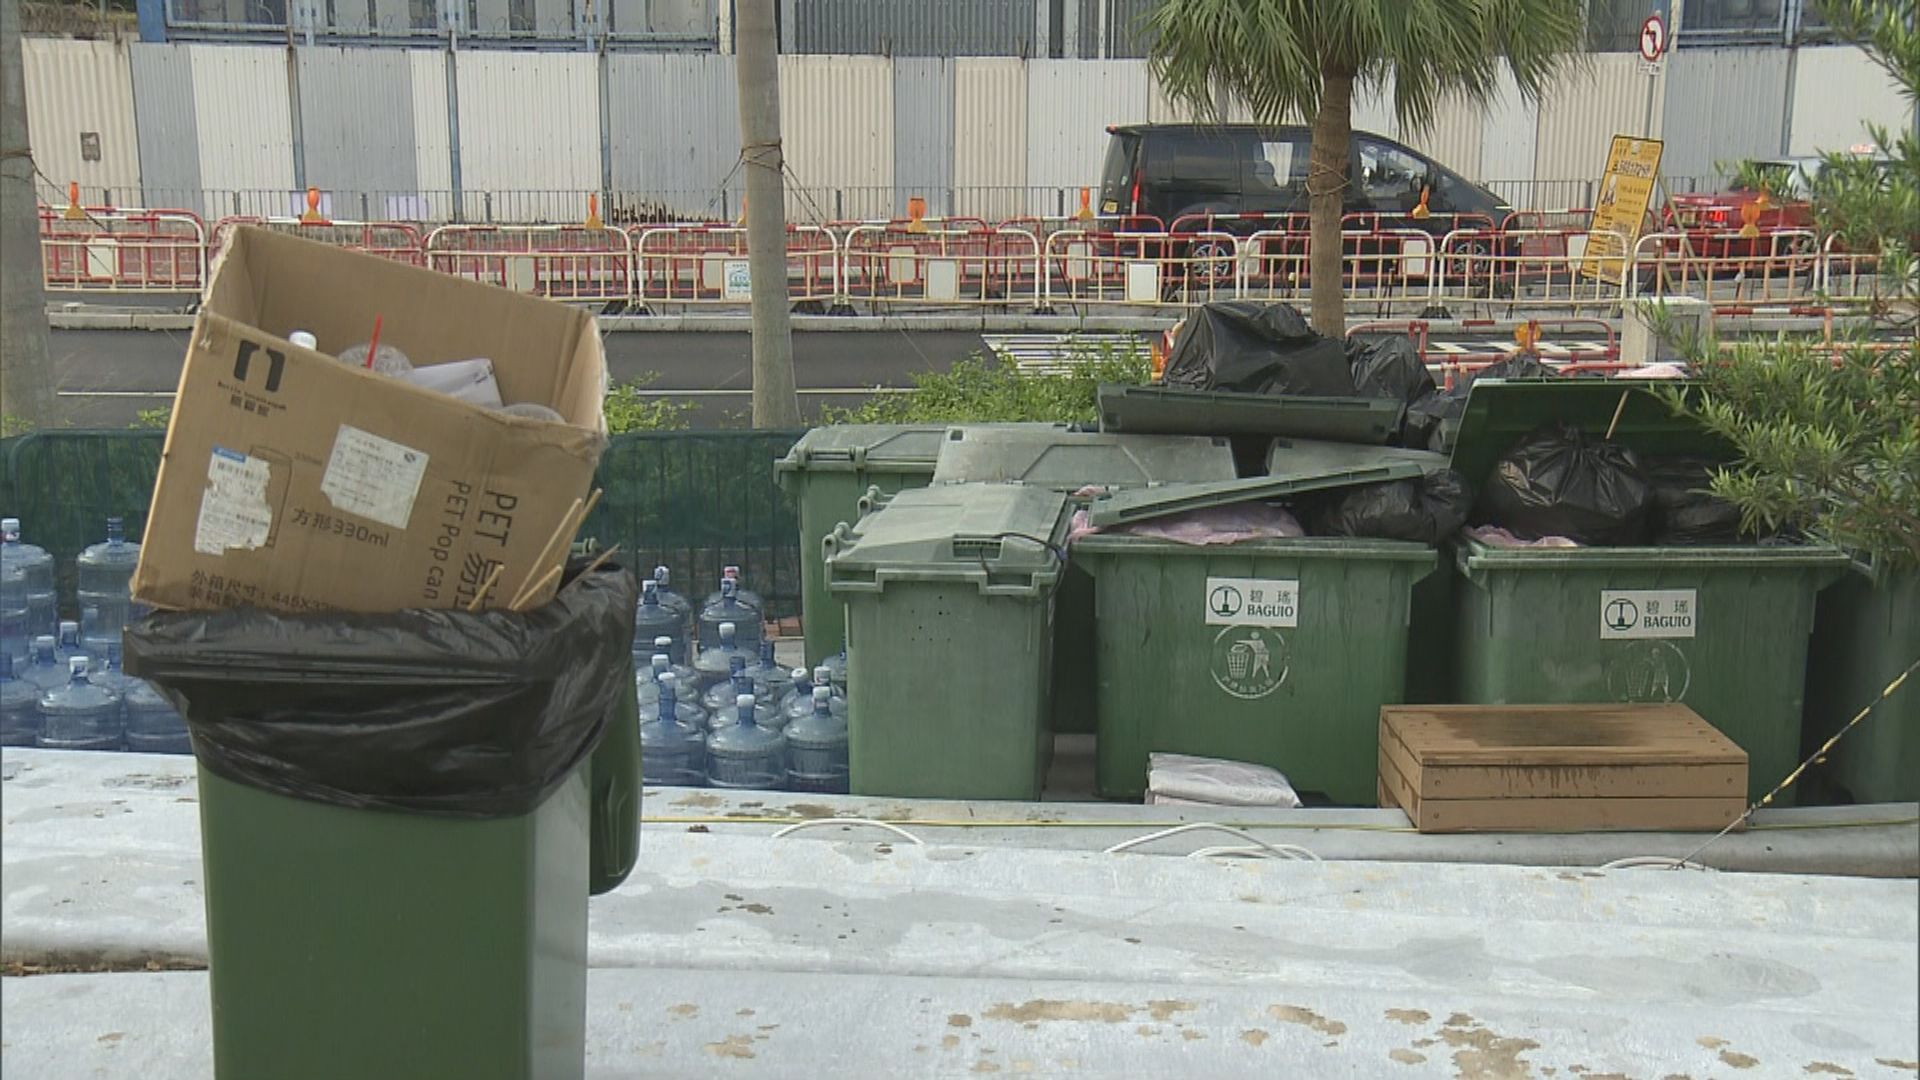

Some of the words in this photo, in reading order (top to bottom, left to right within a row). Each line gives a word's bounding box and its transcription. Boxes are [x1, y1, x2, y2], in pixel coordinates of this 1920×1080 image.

[444, 480, 472, 520] PET
[475, 489, 518, 547] PET
[424, 566, 445, 600] can
[1247, 604, 1294, 617] BAGUIO
[1643, 615, 1692, 628] BAGUIO
